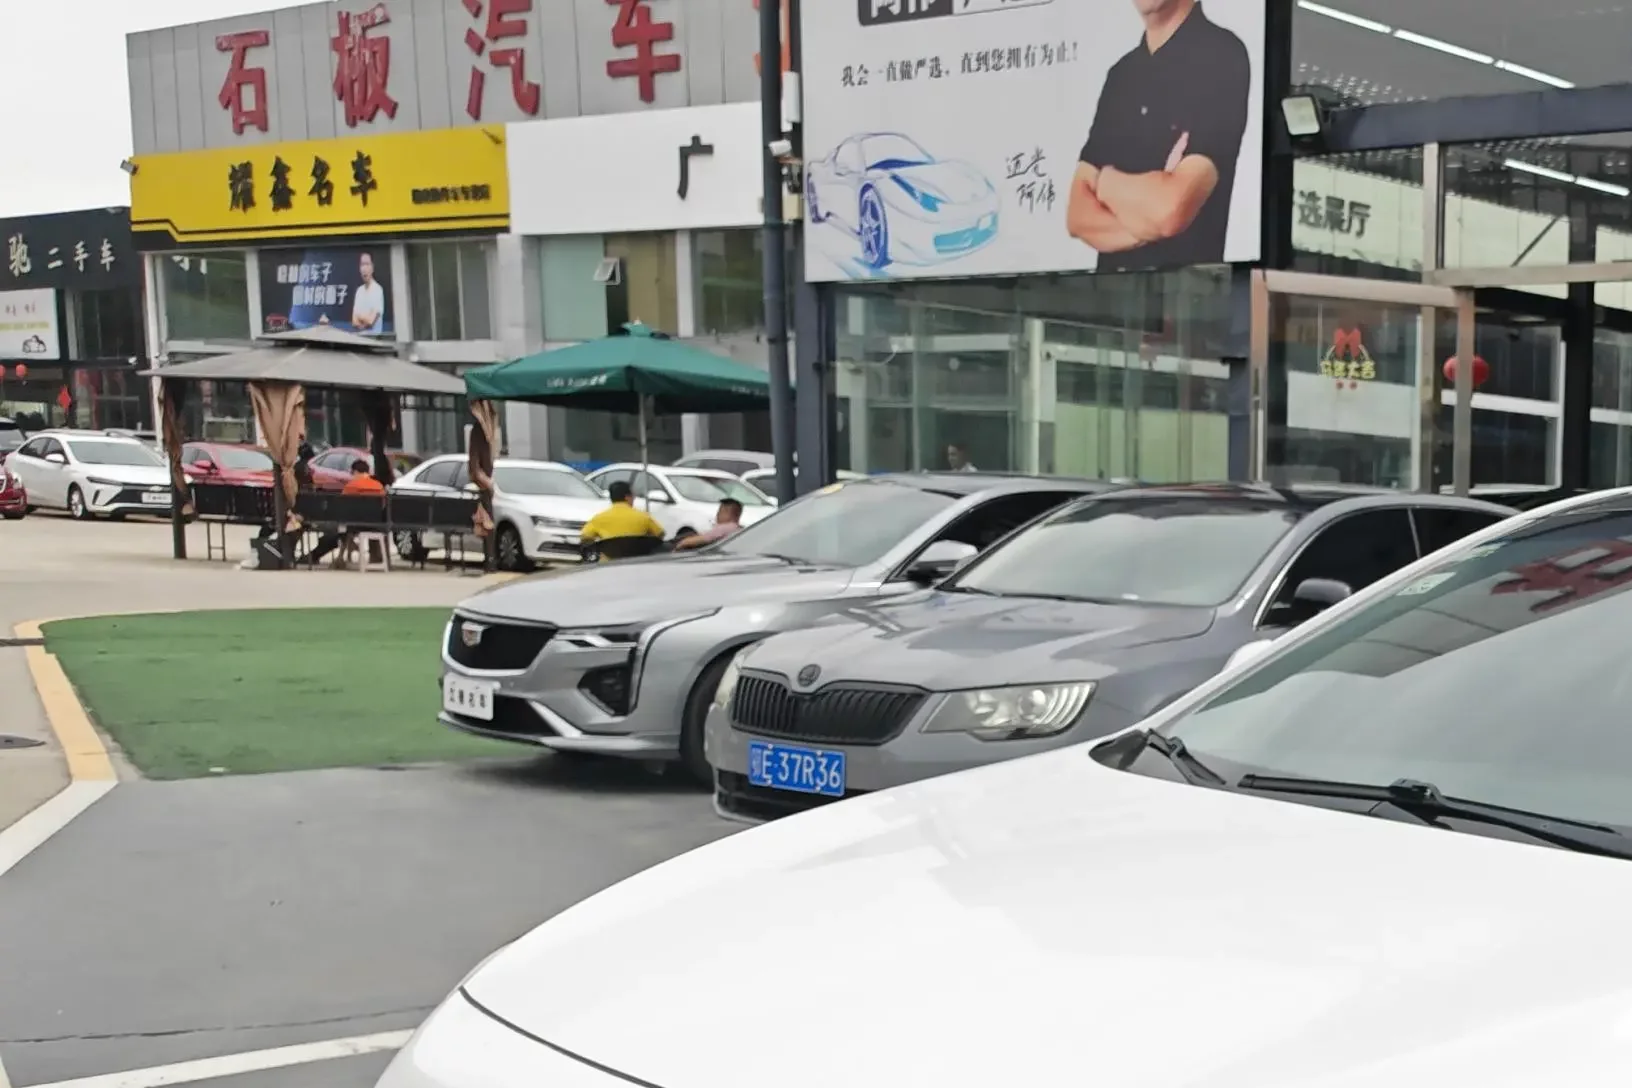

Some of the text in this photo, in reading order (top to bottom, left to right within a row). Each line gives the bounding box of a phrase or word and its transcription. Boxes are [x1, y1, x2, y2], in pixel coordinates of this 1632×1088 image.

[215, 0, 760, 136] 石板汽车
[677, 134, 714, 200] 广
